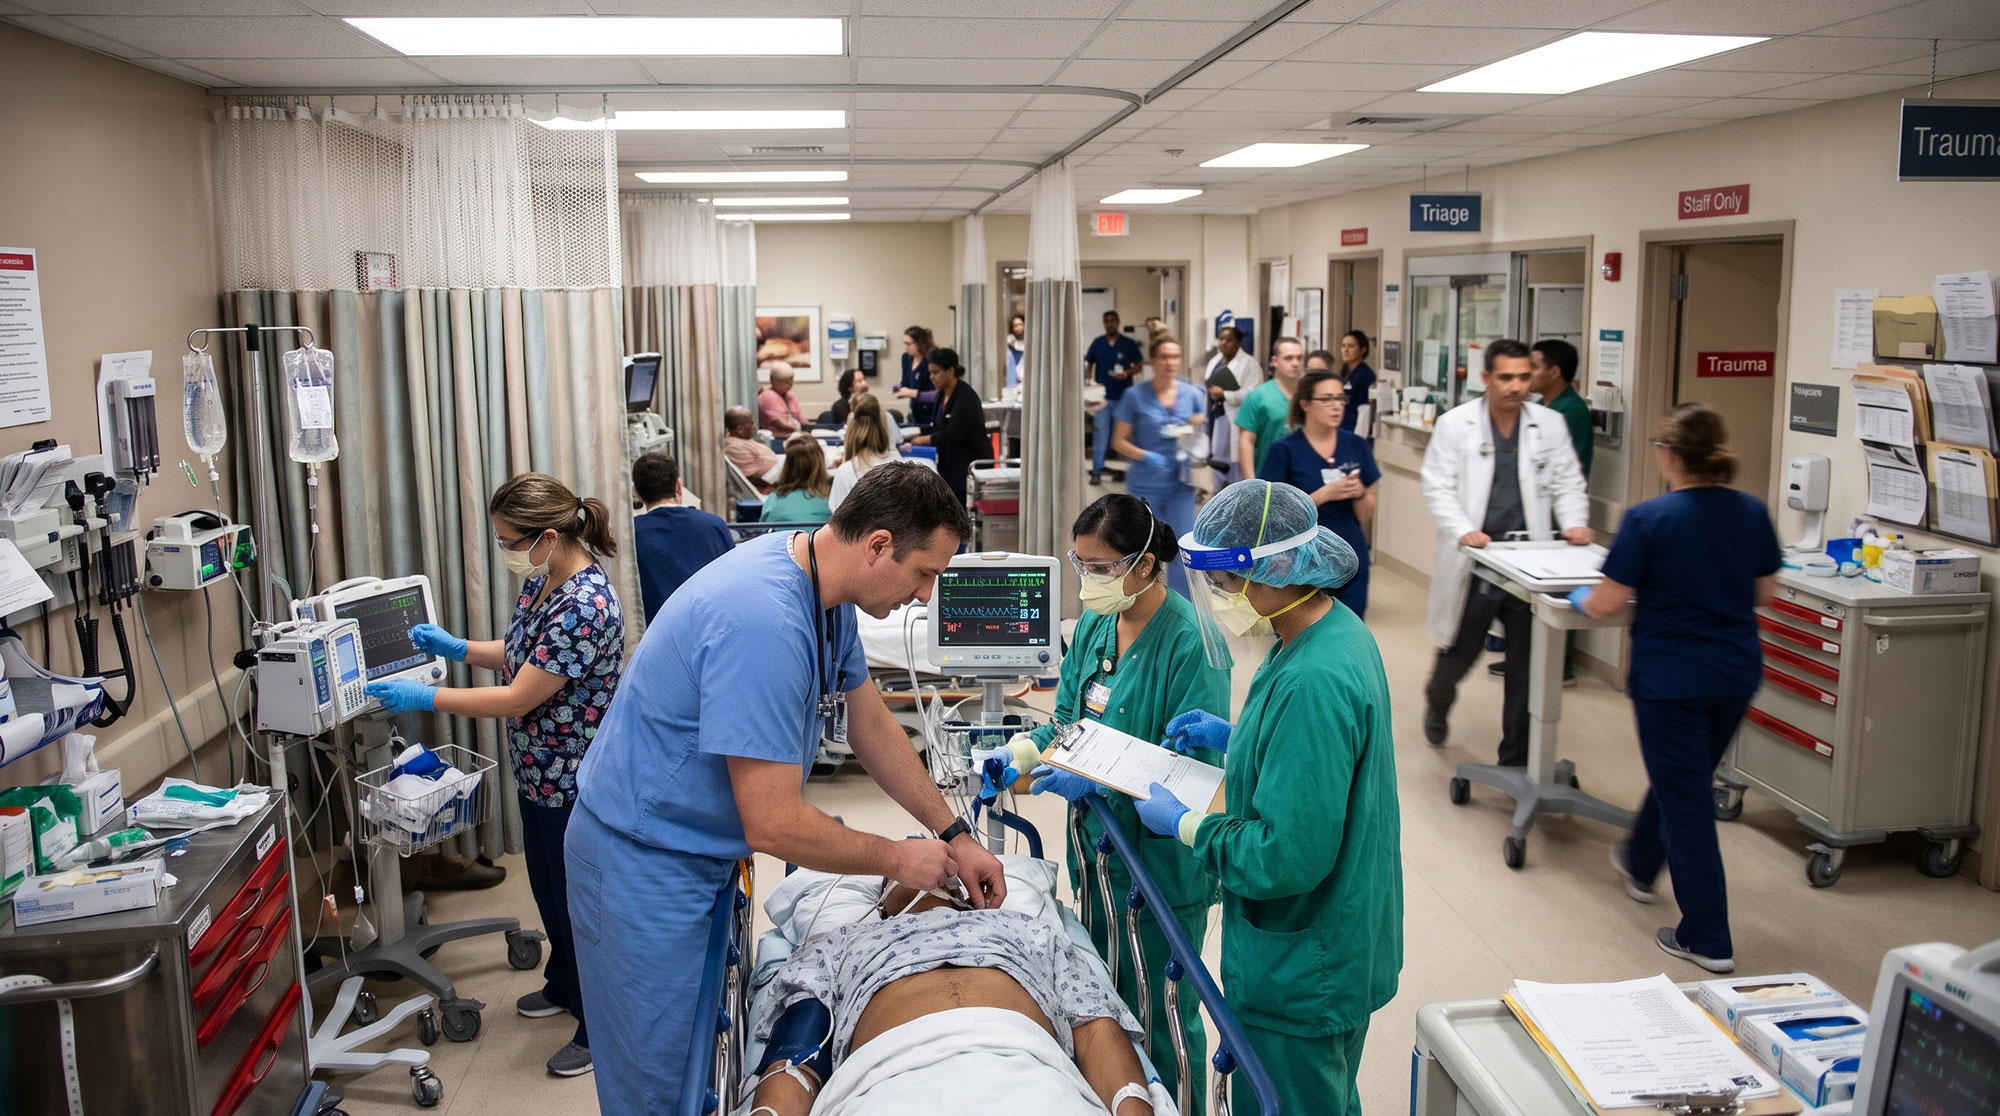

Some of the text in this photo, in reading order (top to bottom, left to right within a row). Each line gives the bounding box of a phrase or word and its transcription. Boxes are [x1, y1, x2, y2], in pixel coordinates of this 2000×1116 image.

[1914, 127, 2000, 156] Traum
[1683, 191, 1743, 213] Staff Only
[1420, 203, 1469, 226] Triage
[1707, 356, 1767, 372] Trauma
